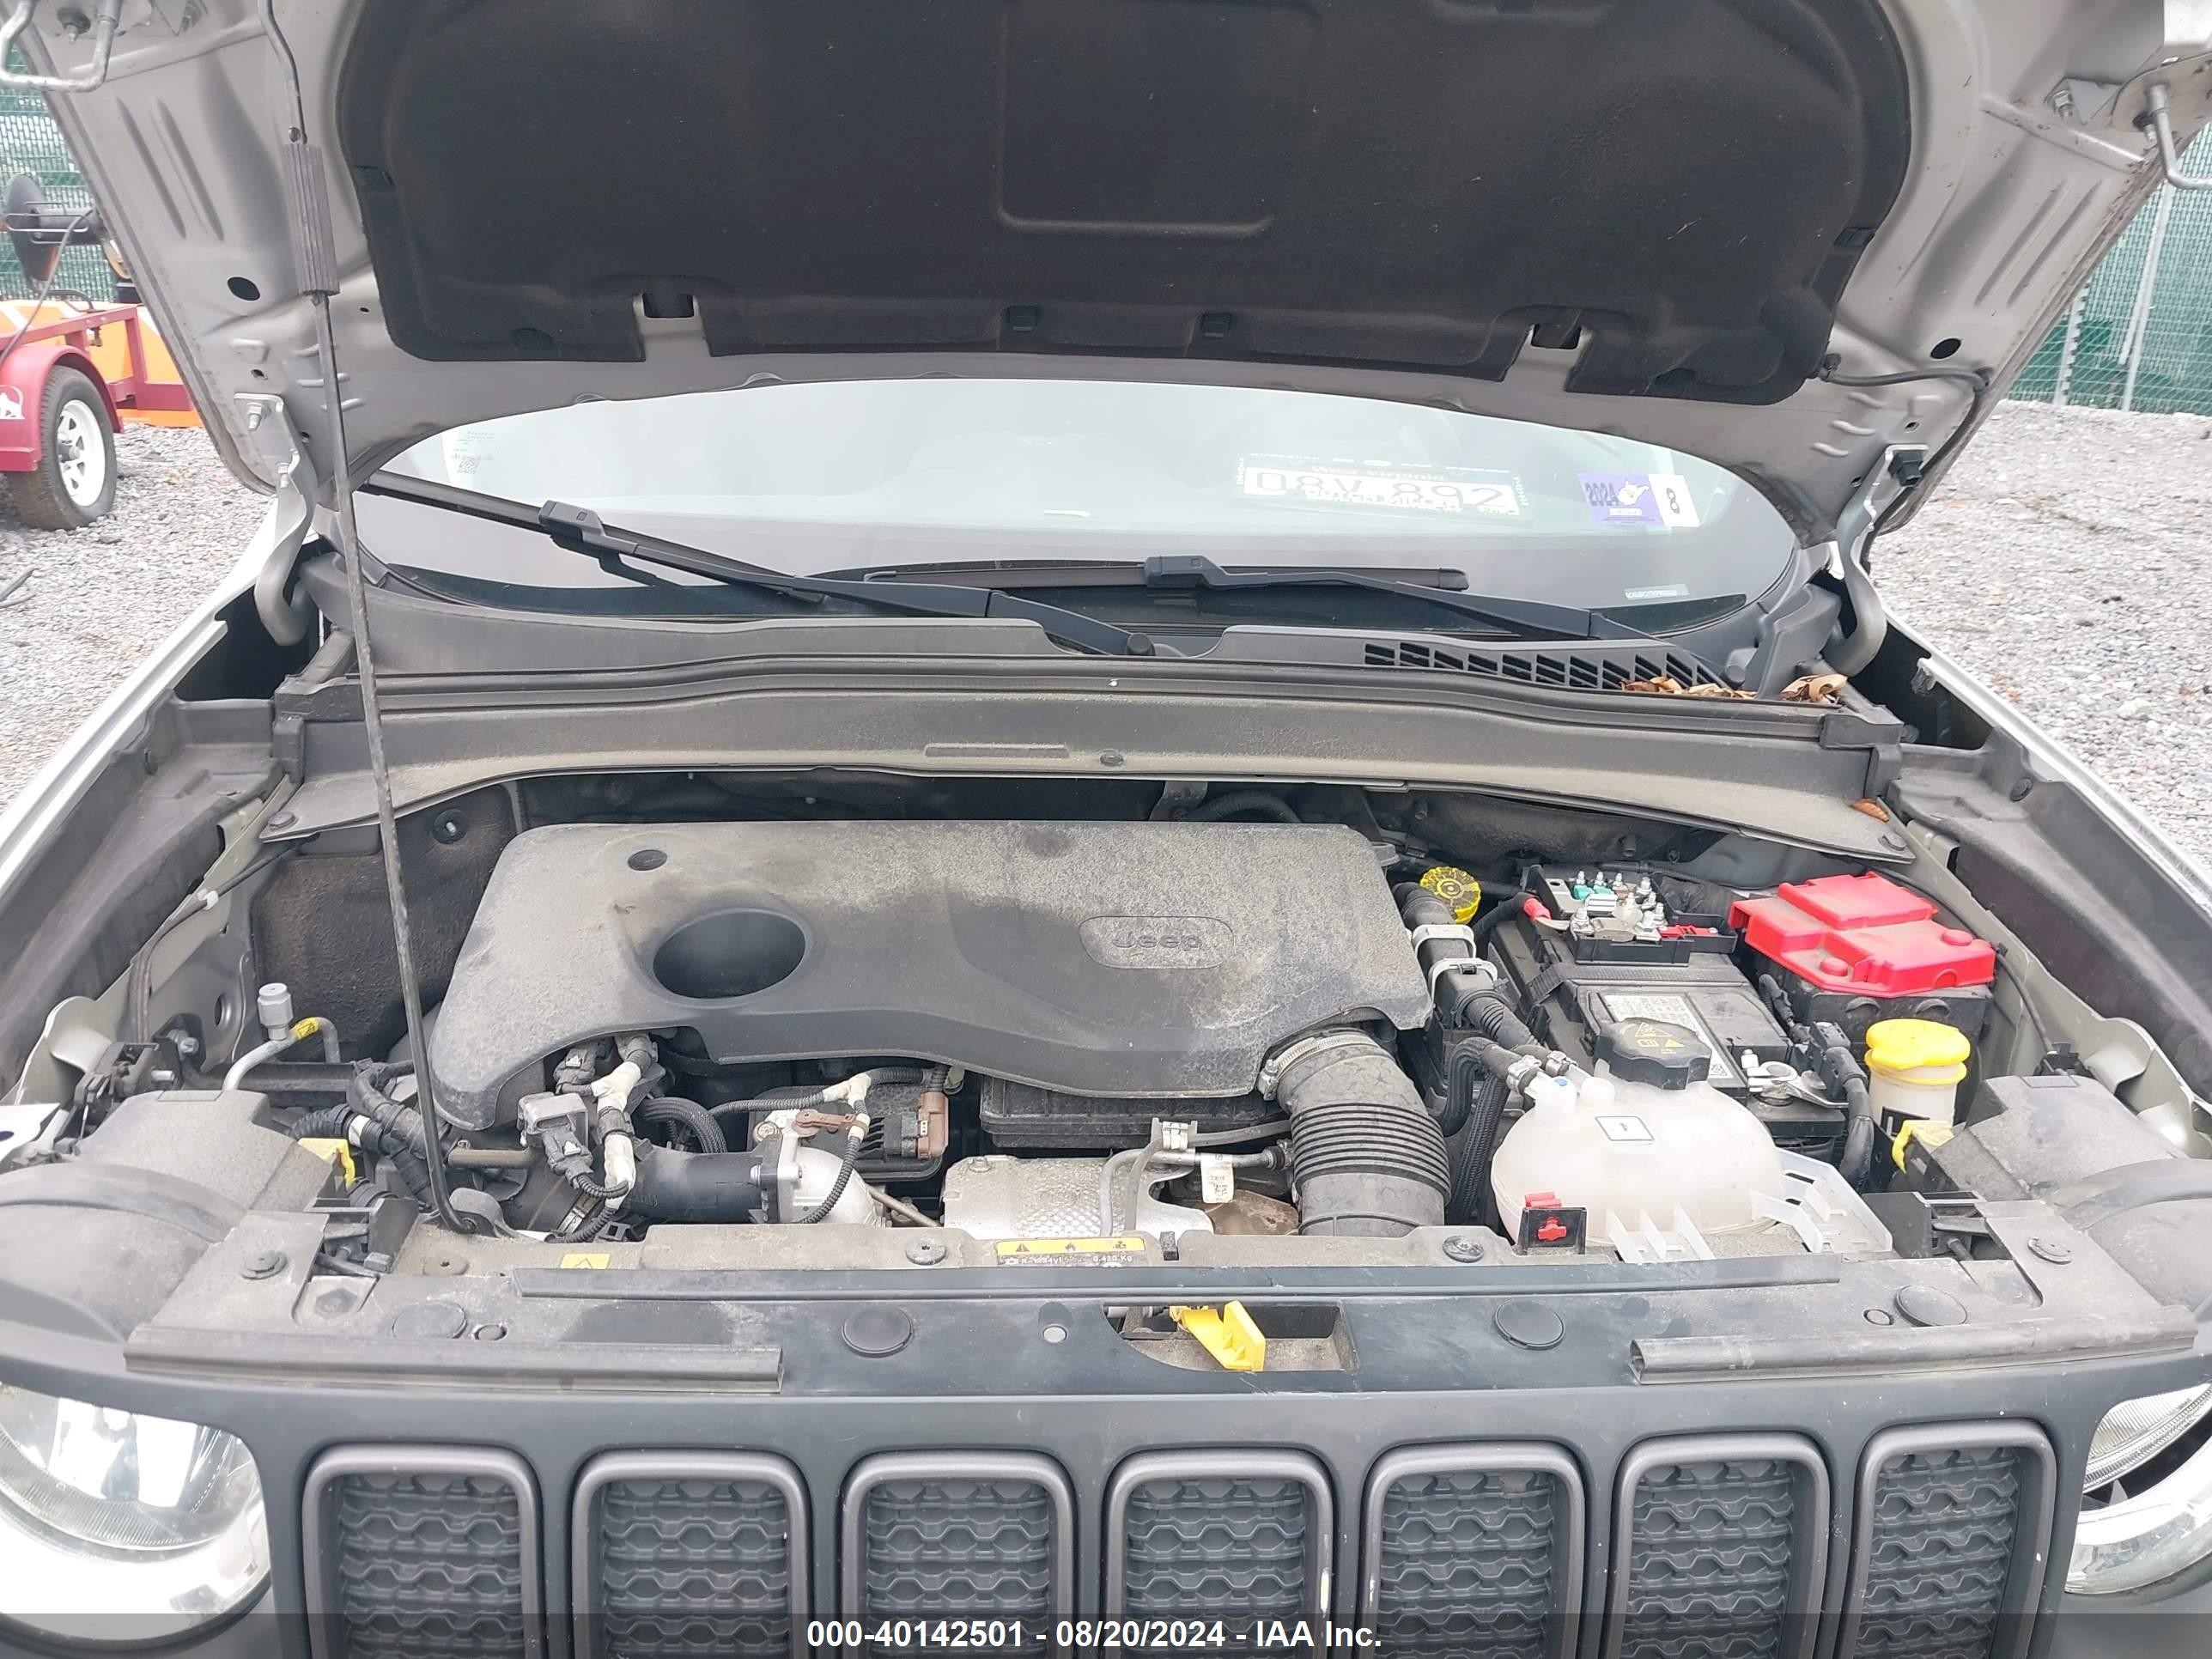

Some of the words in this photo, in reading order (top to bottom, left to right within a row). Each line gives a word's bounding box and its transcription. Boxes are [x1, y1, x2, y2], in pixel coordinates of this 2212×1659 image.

[1584, 482, 1620, 507] 2024
[1666, 487, 1680, 514] 8
[1111, 930, 1203, 952] Jeep
